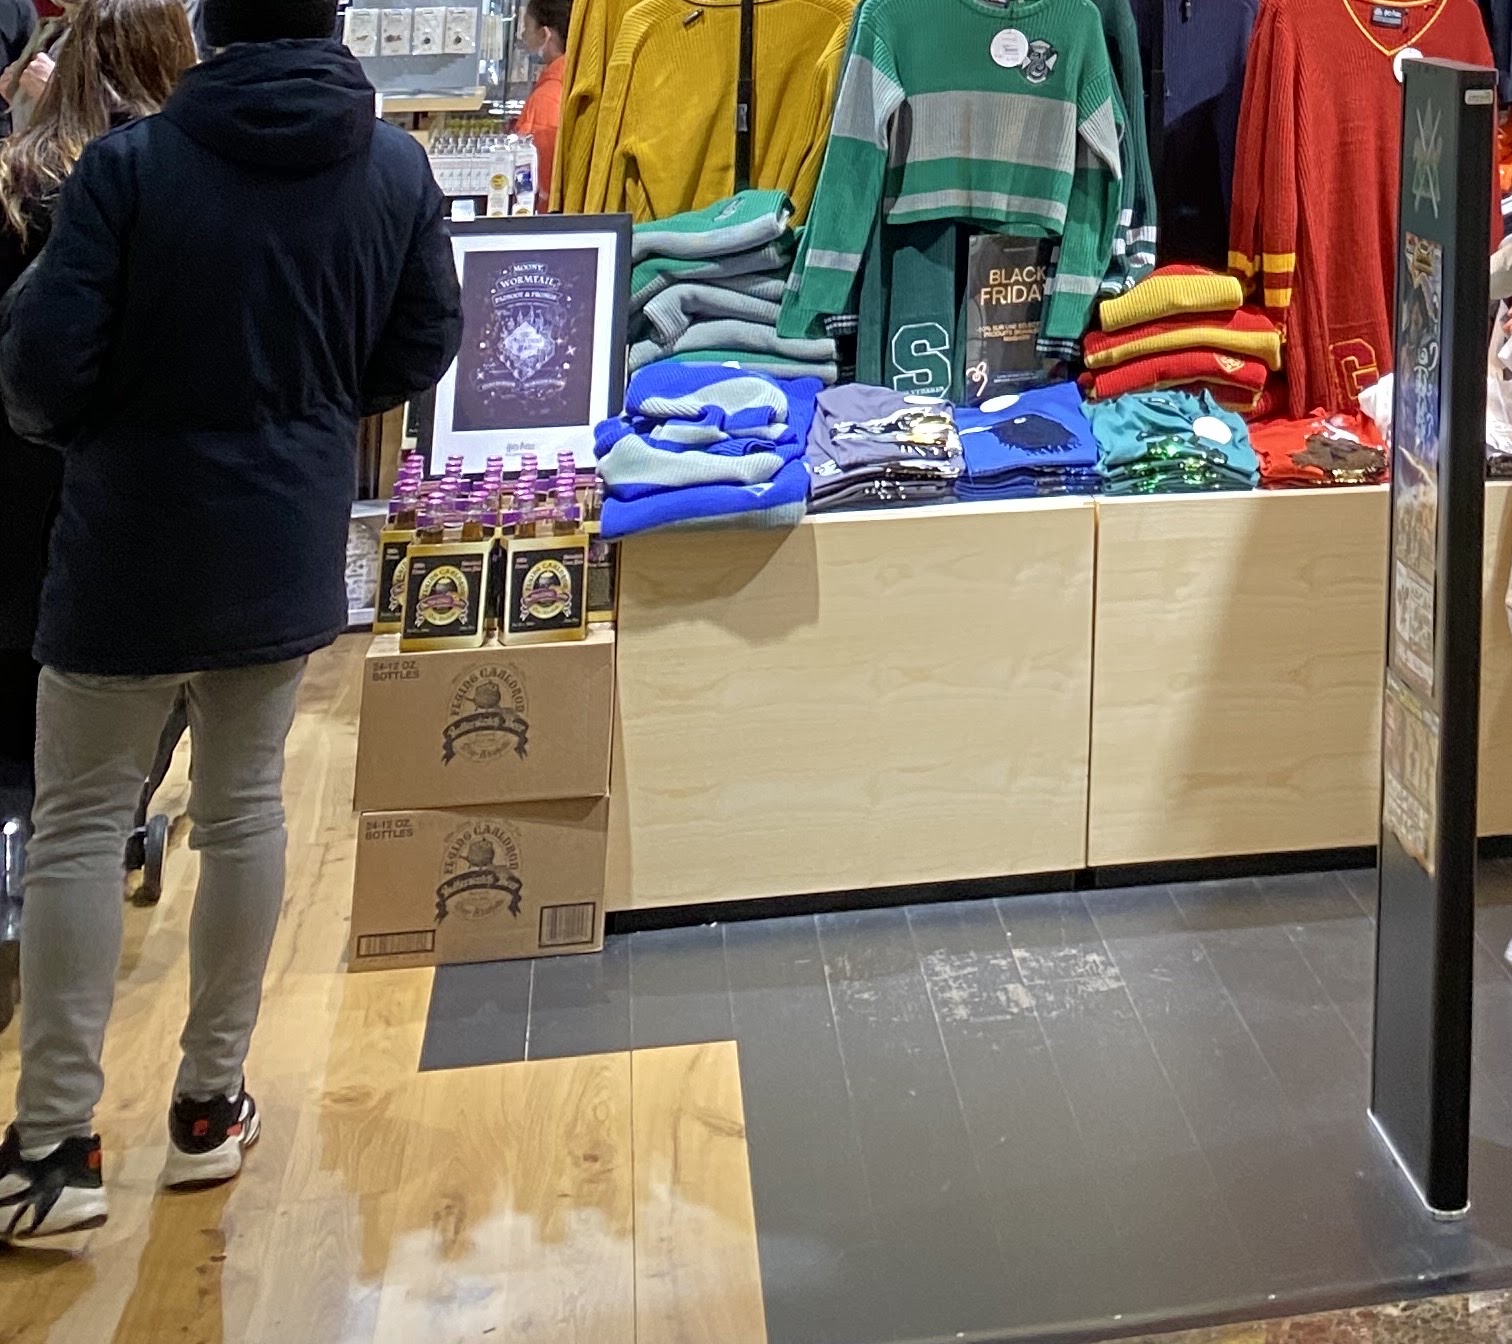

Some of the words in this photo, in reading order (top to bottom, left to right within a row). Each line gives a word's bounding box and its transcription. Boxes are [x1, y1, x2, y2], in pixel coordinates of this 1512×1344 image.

[989, 265, 1047, 286] BLACK
[372, 669, 420, 682] BOTTLES
[365, 828, 414, 841] BOTTLES
